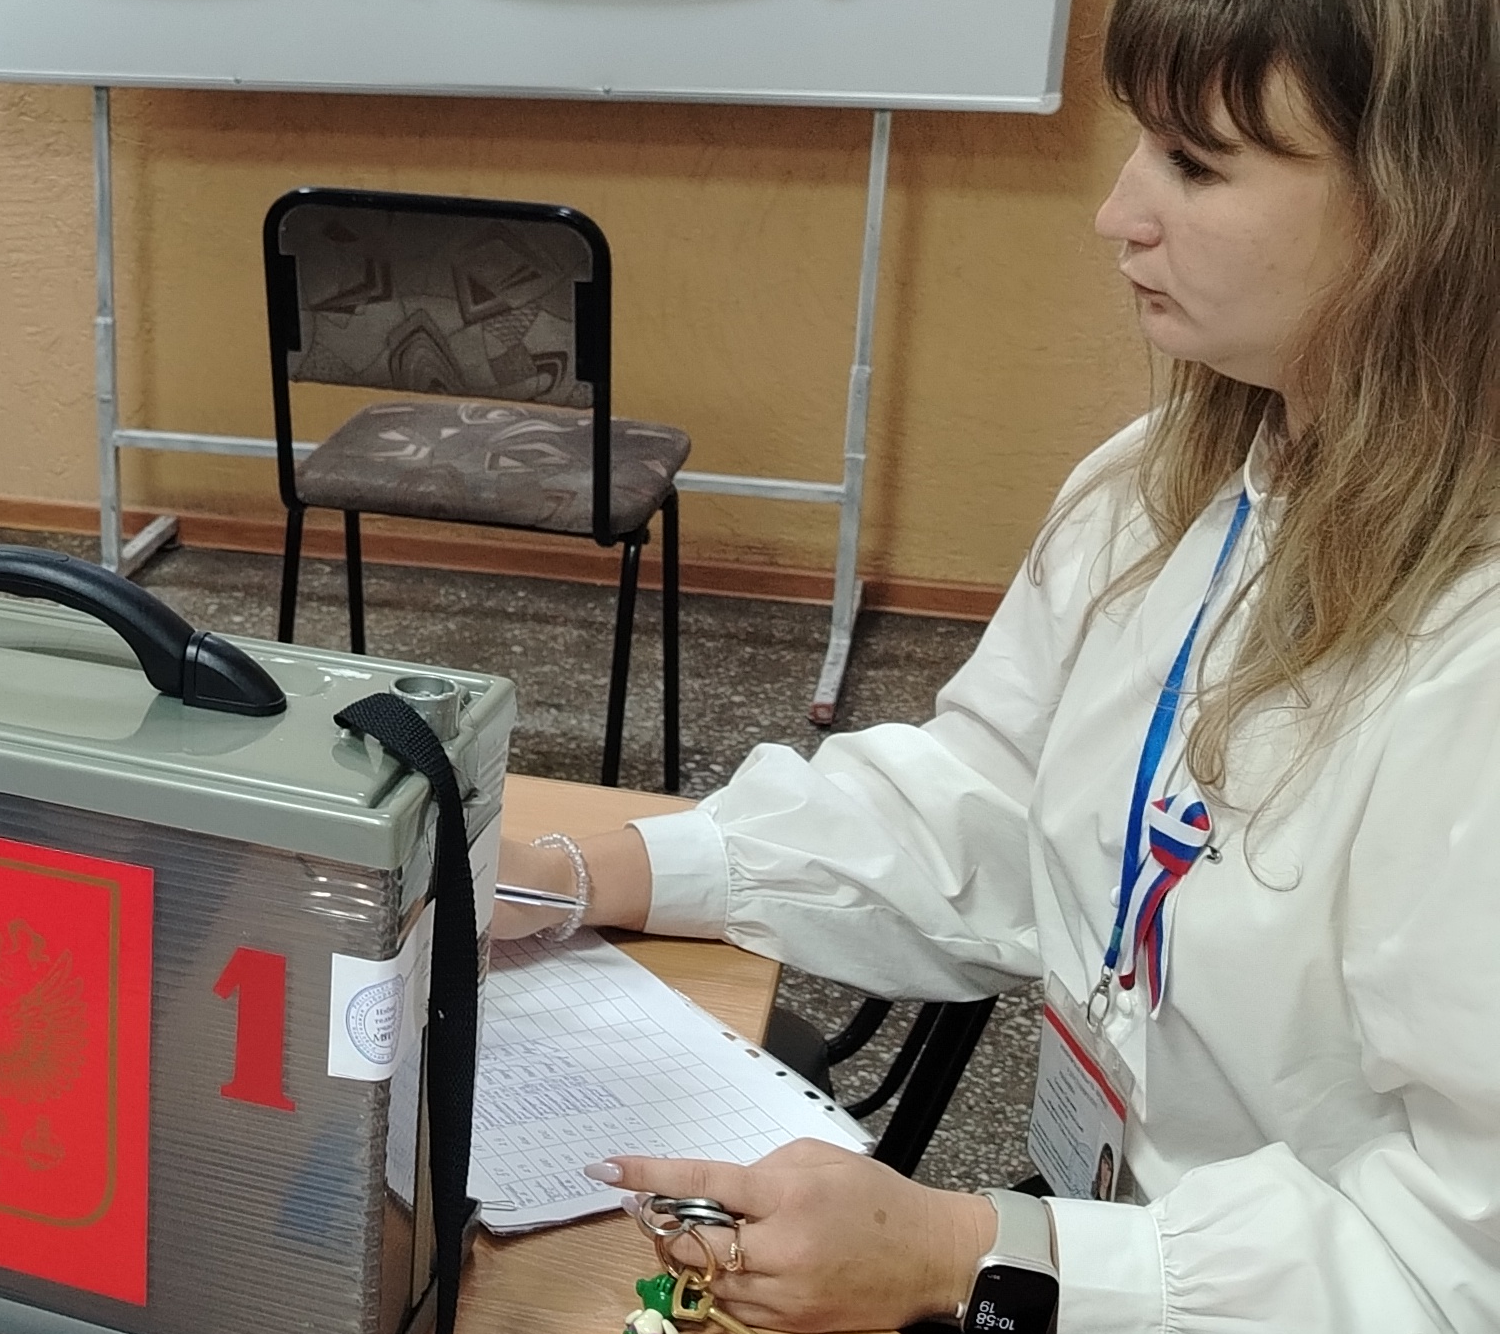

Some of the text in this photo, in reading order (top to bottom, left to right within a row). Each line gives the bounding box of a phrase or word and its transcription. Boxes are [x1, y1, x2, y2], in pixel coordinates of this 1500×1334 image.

[213, 945, 296, 1112] 1
[979, 1300, 995, 1314] 19
[976, 1312, 1015, 1331] 10:58
